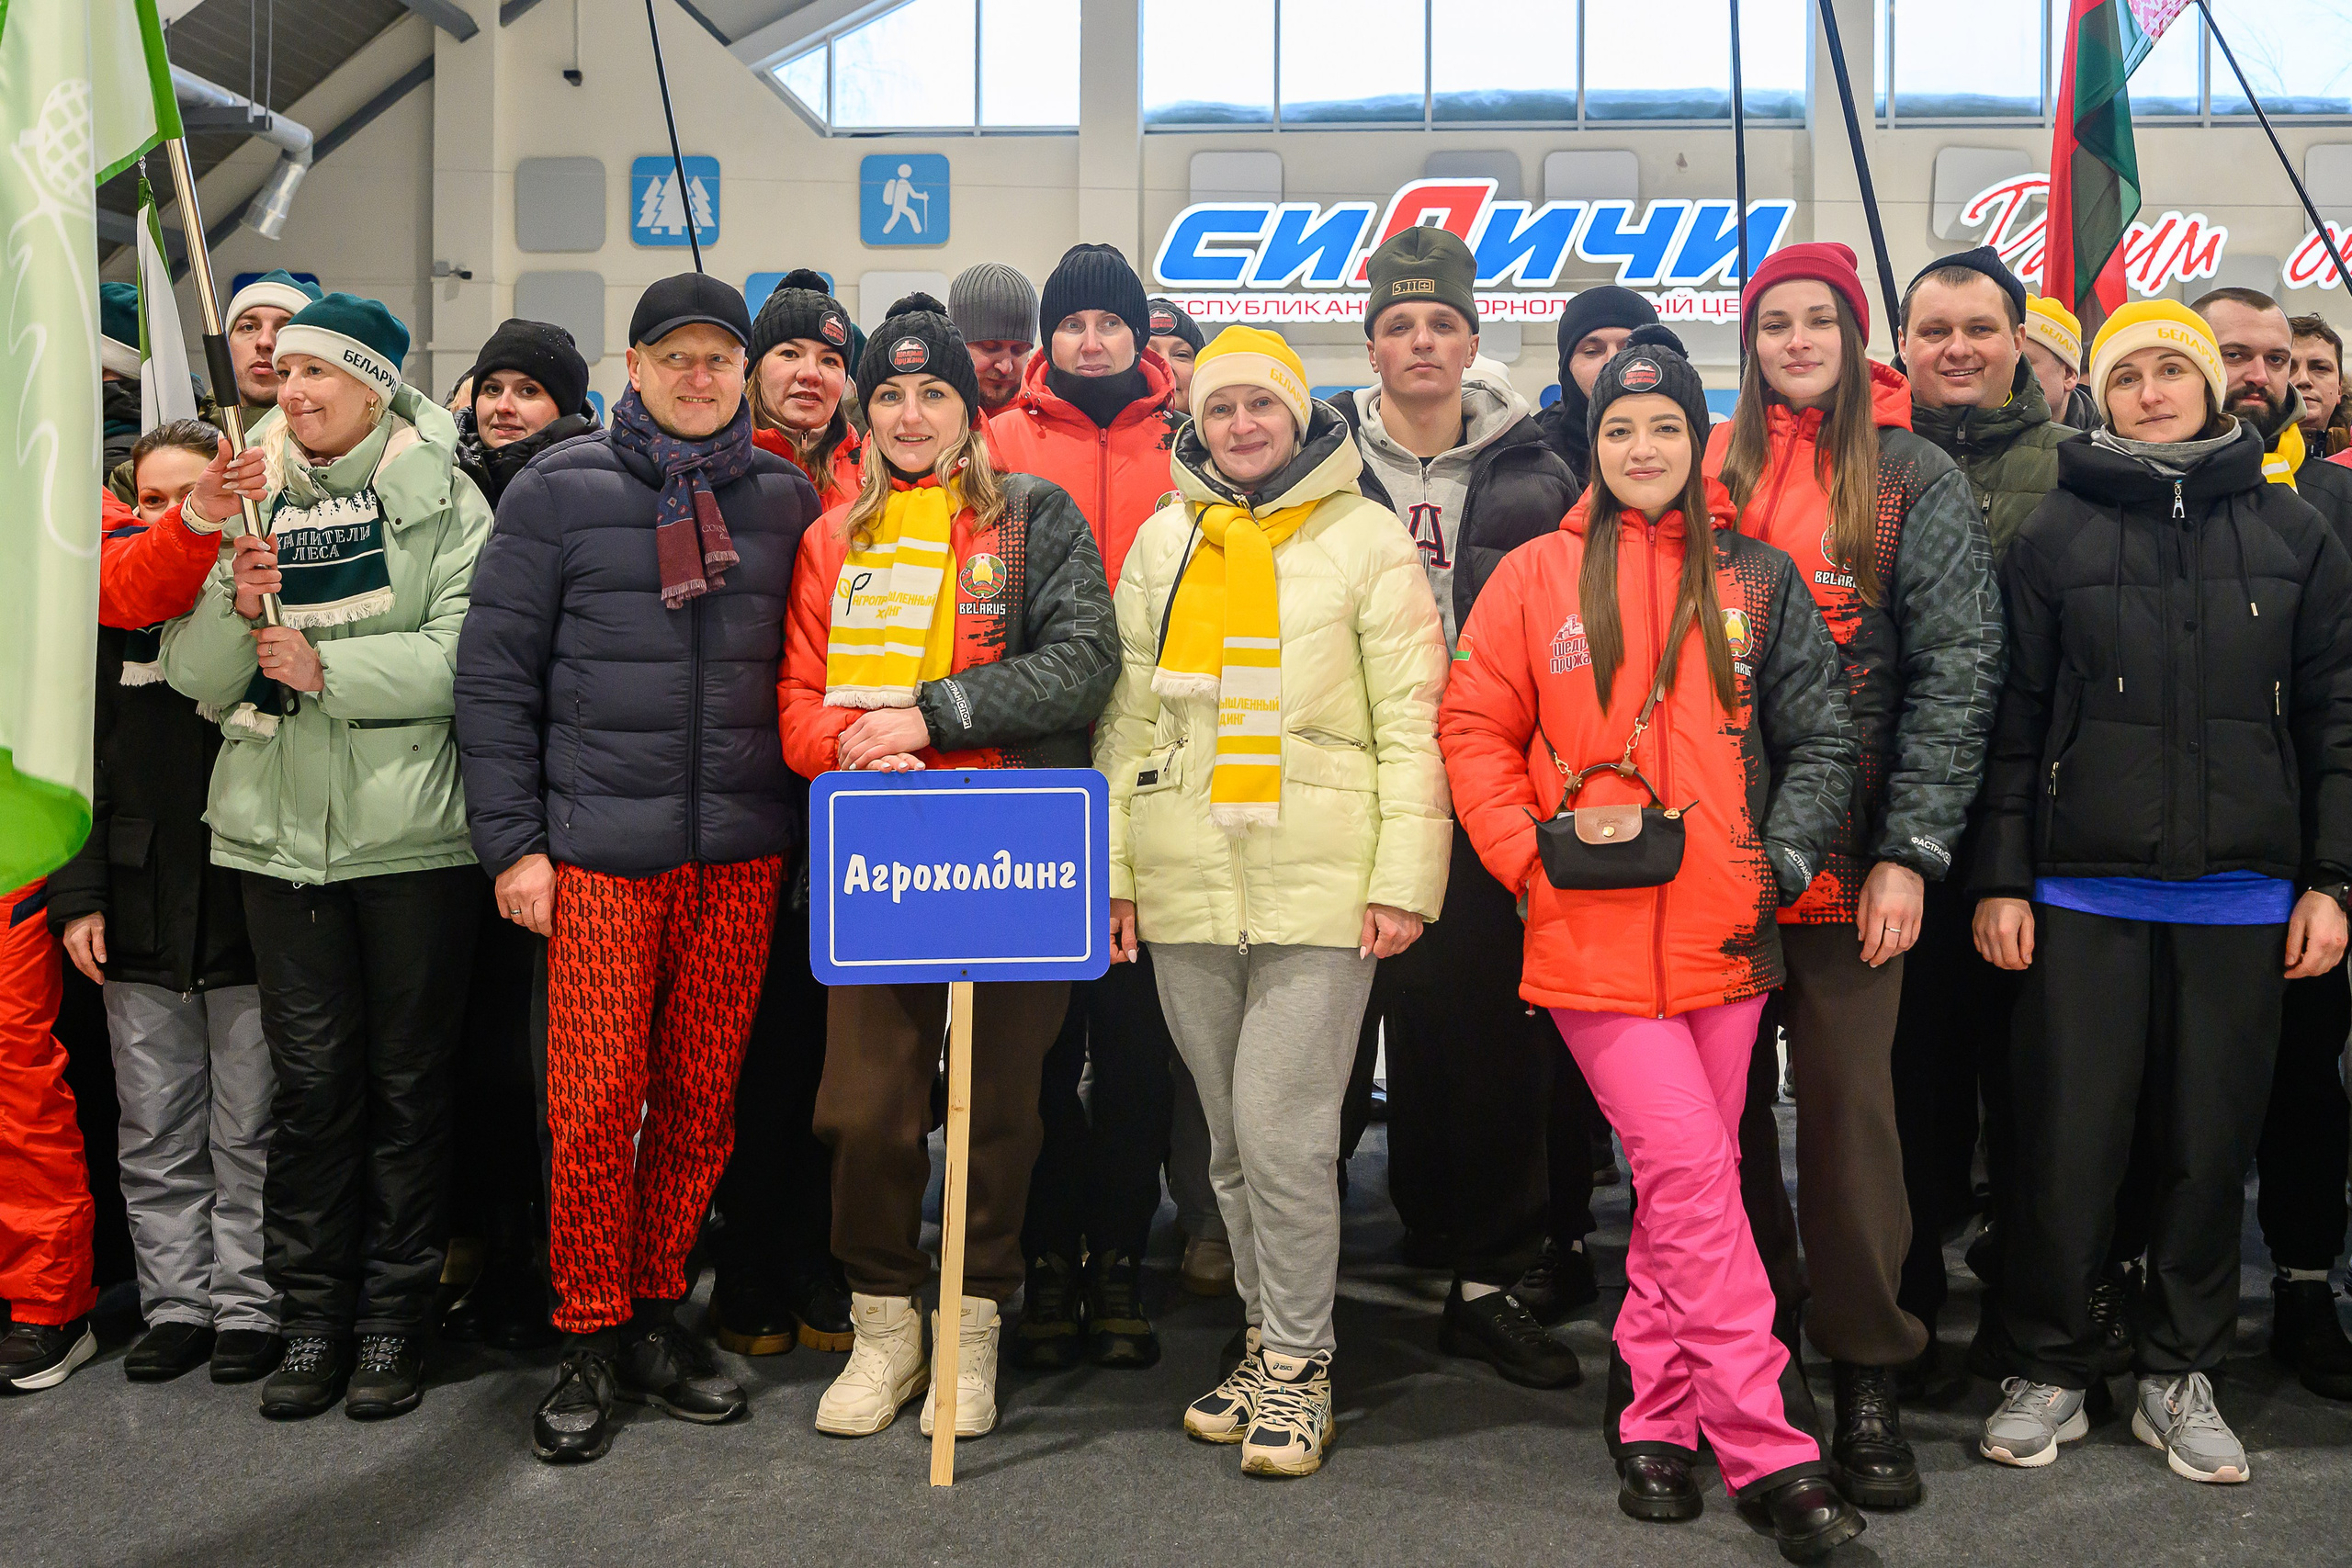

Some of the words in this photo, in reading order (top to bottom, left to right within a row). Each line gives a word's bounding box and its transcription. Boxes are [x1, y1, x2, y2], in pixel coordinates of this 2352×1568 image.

[1173, 299, 1368, 316] ЕСПУБЛИКАН
[1702, 299, 1740, 317] ЦЕ
[343, 349, 397, 396] БЕЛАРУС
[292, 544, 341, 561] ЛЕСА
[1815, 570, 1857, 589] BELAR
[958, 602, 1007, 615] BELARUS
[1554, 638, 1588, 657] Щедр
[1550, 653, 1590, 673] Пружа
[1734, 661, 1752, 678] ARUS
[1219, 696, 1280, 712] ЫШЛЕННЫЙ
[957, 701, 972, 728] СПОРТ
[1218, 713, 1247, 728] ДИНГ
[842, 849, 1077, 904] Агрохолдинг
